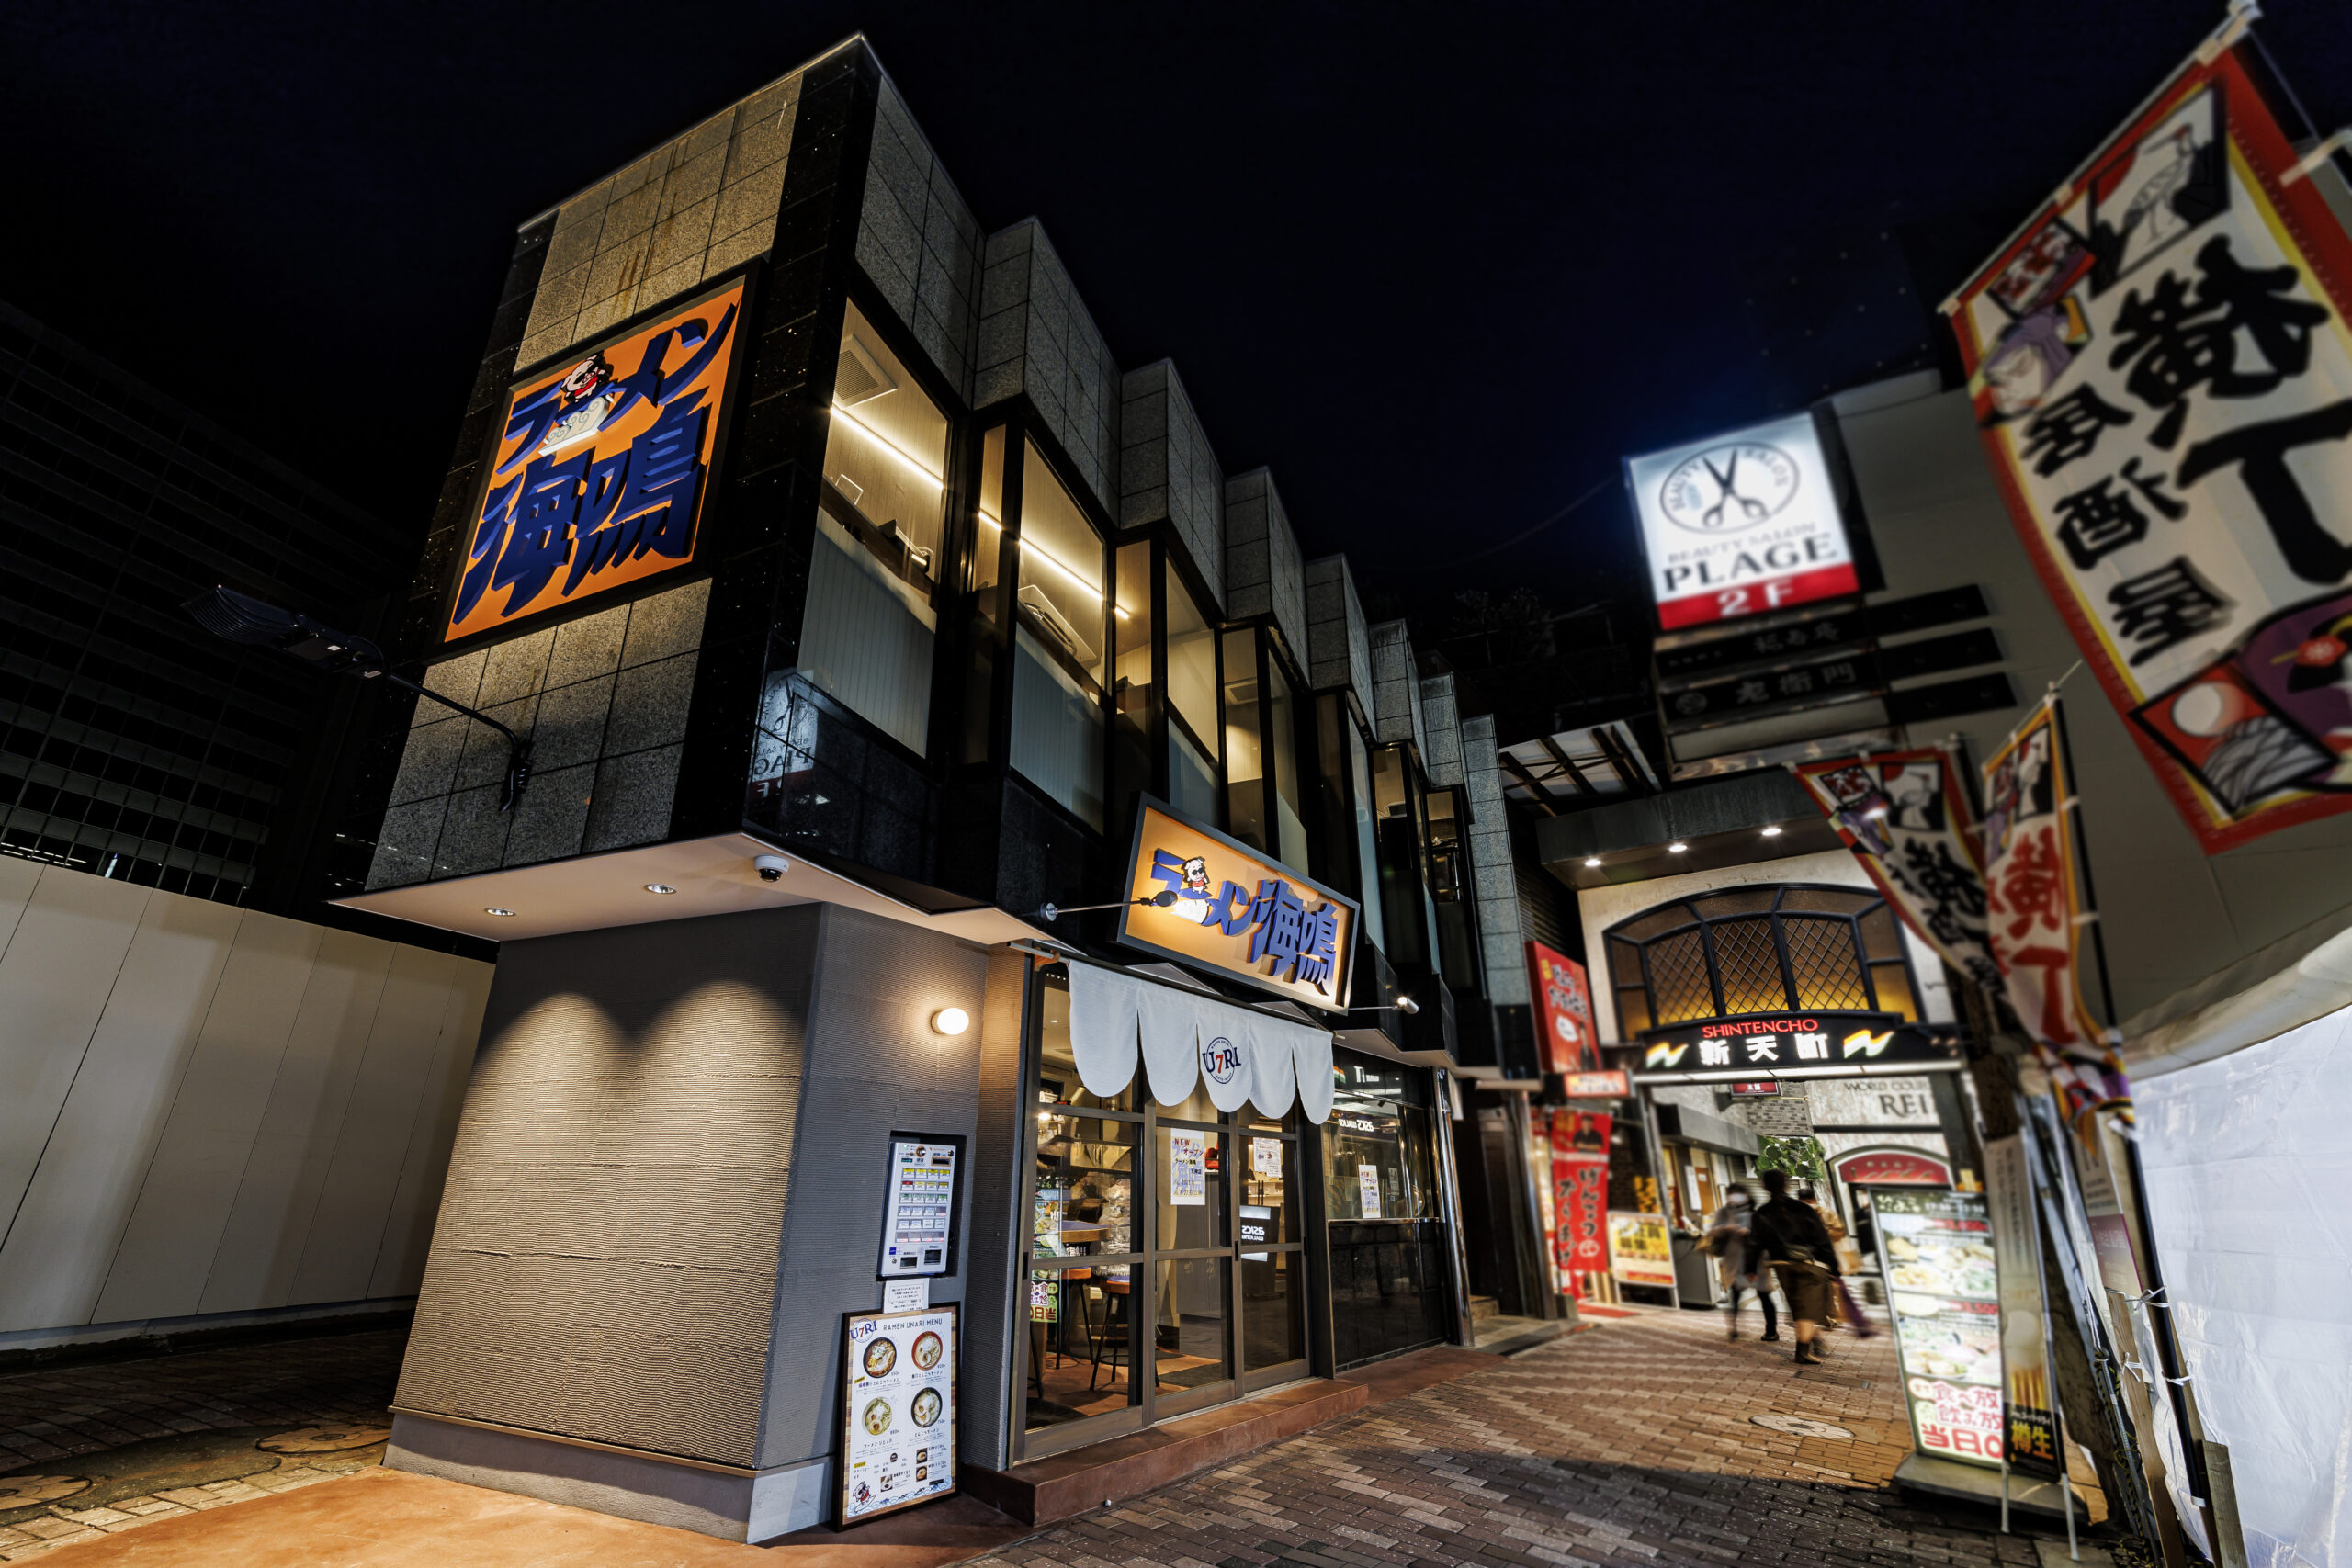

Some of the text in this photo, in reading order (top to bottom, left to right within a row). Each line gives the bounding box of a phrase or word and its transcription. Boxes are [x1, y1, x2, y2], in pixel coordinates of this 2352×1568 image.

[452, 388, 714, 626] 海鳴
[1663, 532, 1838, 592] PLAGE
[1702, 1019, 1818, 1038] SHINTENCHO
[1699, 1033, 1829, 1066] 新天町
[1879, 1094, 1928, 1117] REI
[1174, 1138, 1190, 1146] NEW
[883, 1317, 944, 1332] RAMEN UNARI MENU
